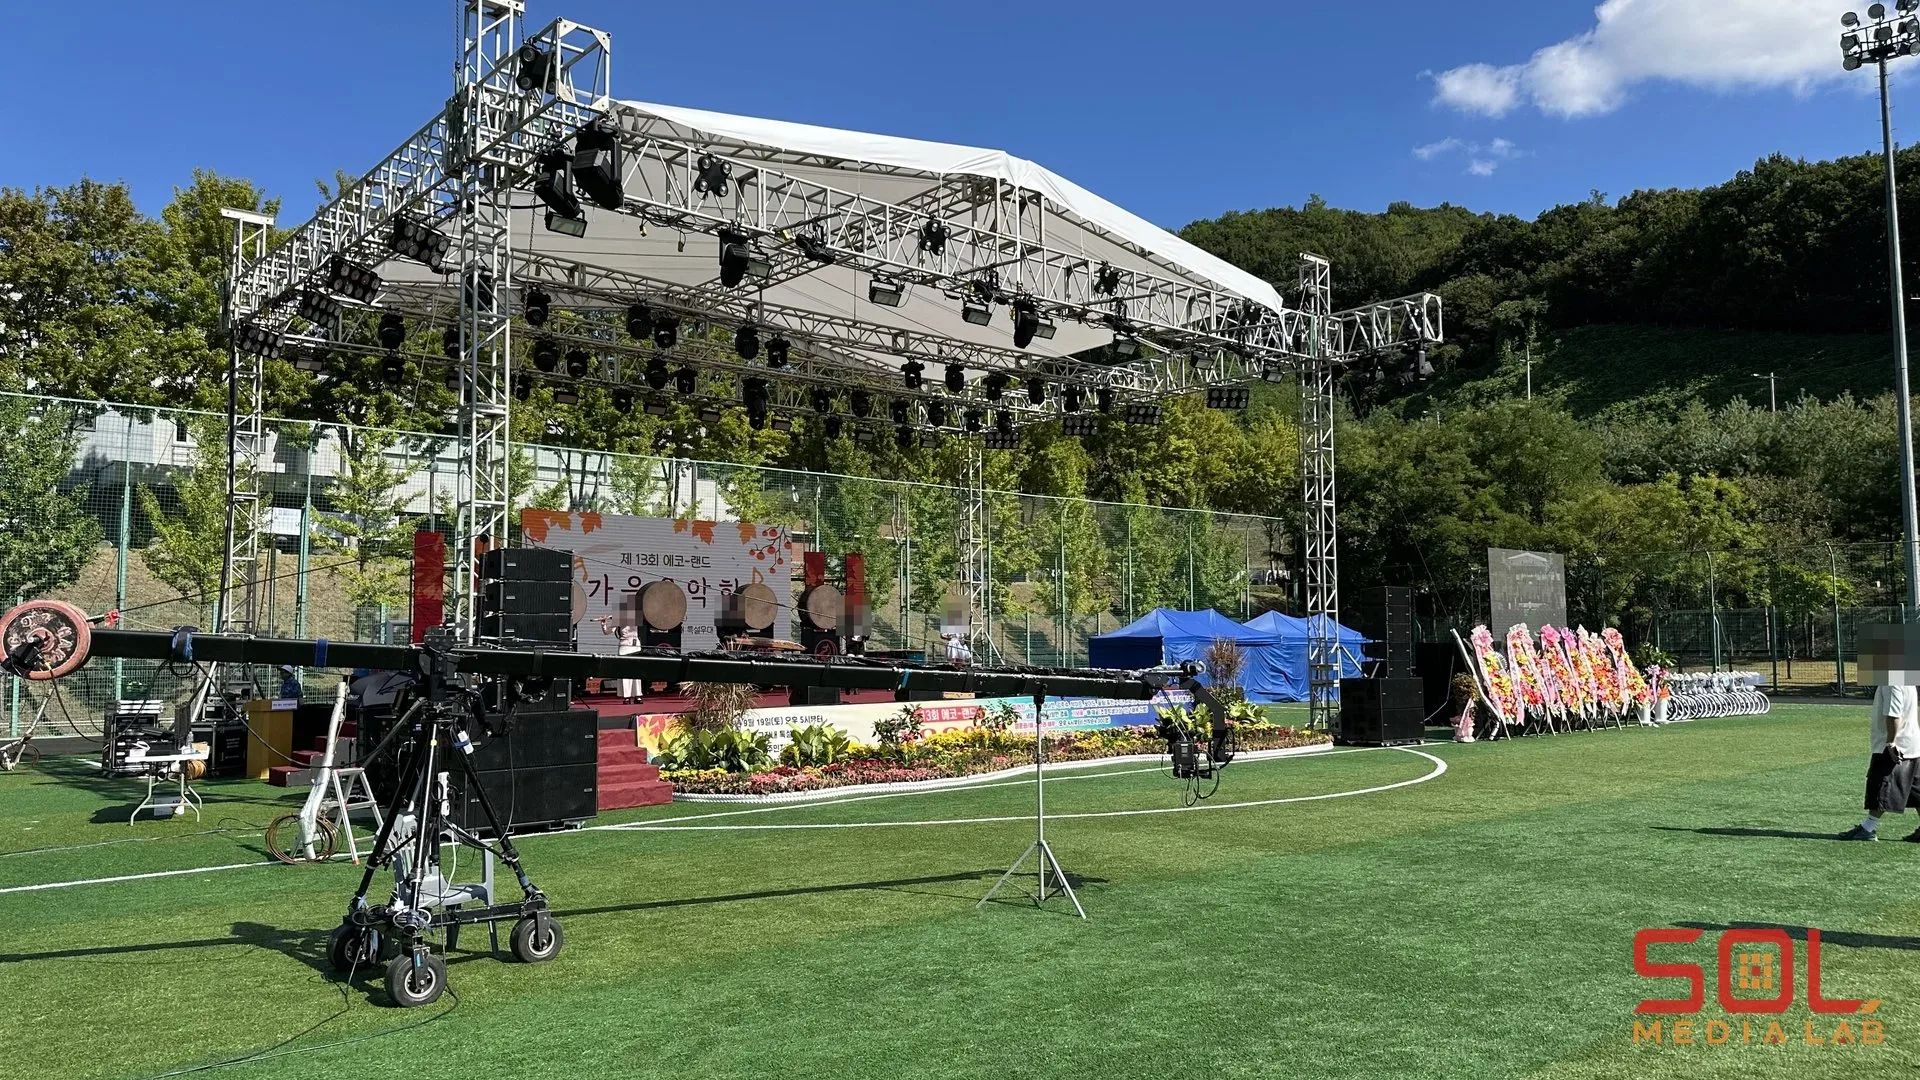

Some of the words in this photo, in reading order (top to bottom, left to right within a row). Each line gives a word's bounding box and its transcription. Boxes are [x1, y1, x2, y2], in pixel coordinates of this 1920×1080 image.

[620, 552, 632, 566] 제
[636, 553, 659, 567] 13회
[663, 554, 712, 569] 에코-랜드
